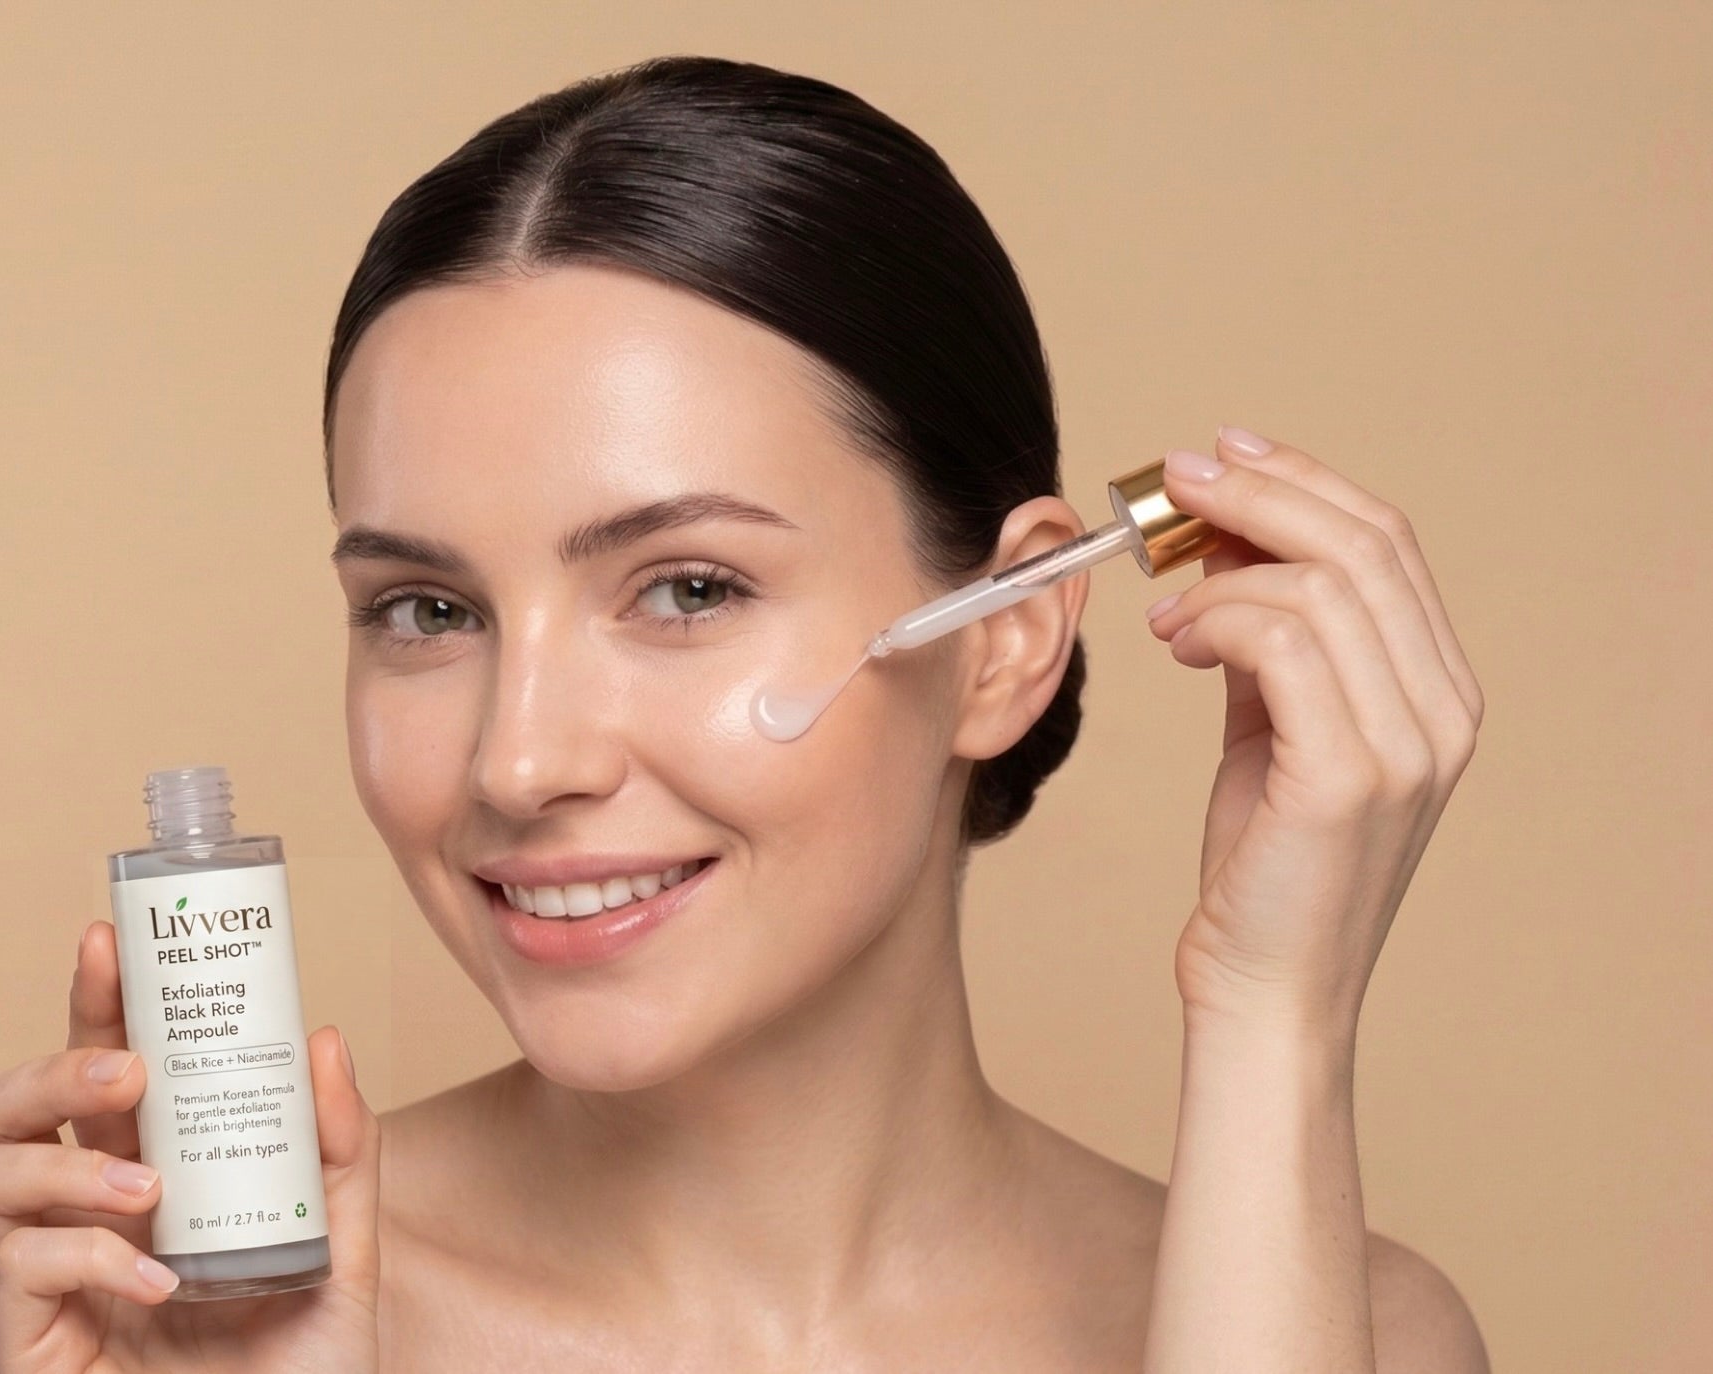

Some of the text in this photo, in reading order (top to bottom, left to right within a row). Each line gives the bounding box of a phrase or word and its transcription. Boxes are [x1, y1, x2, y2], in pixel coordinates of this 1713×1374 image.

[148, 898, 273, 940] Livvera
[158, 948, 198, 965] PEEL
[161, 981, 246, 1001] Exfoliating
[164, 1001, 245, 1021] Black Rice
[167, 1021, 239, 1044] Ampoule
[172, 1049, 292, 1072] Black Rice + Niacinamide
[174, 1082, 295, 1106] Premium Korean formula
[176, 1101, 281, 1122] for gentle exfoliation
[178, 1116, 282, 1136] and skin brightening
[181, 1142, 289, 1163] For all skin types
[189, 1211, 281, 1230] 80 ml / 2.7 fl oz
